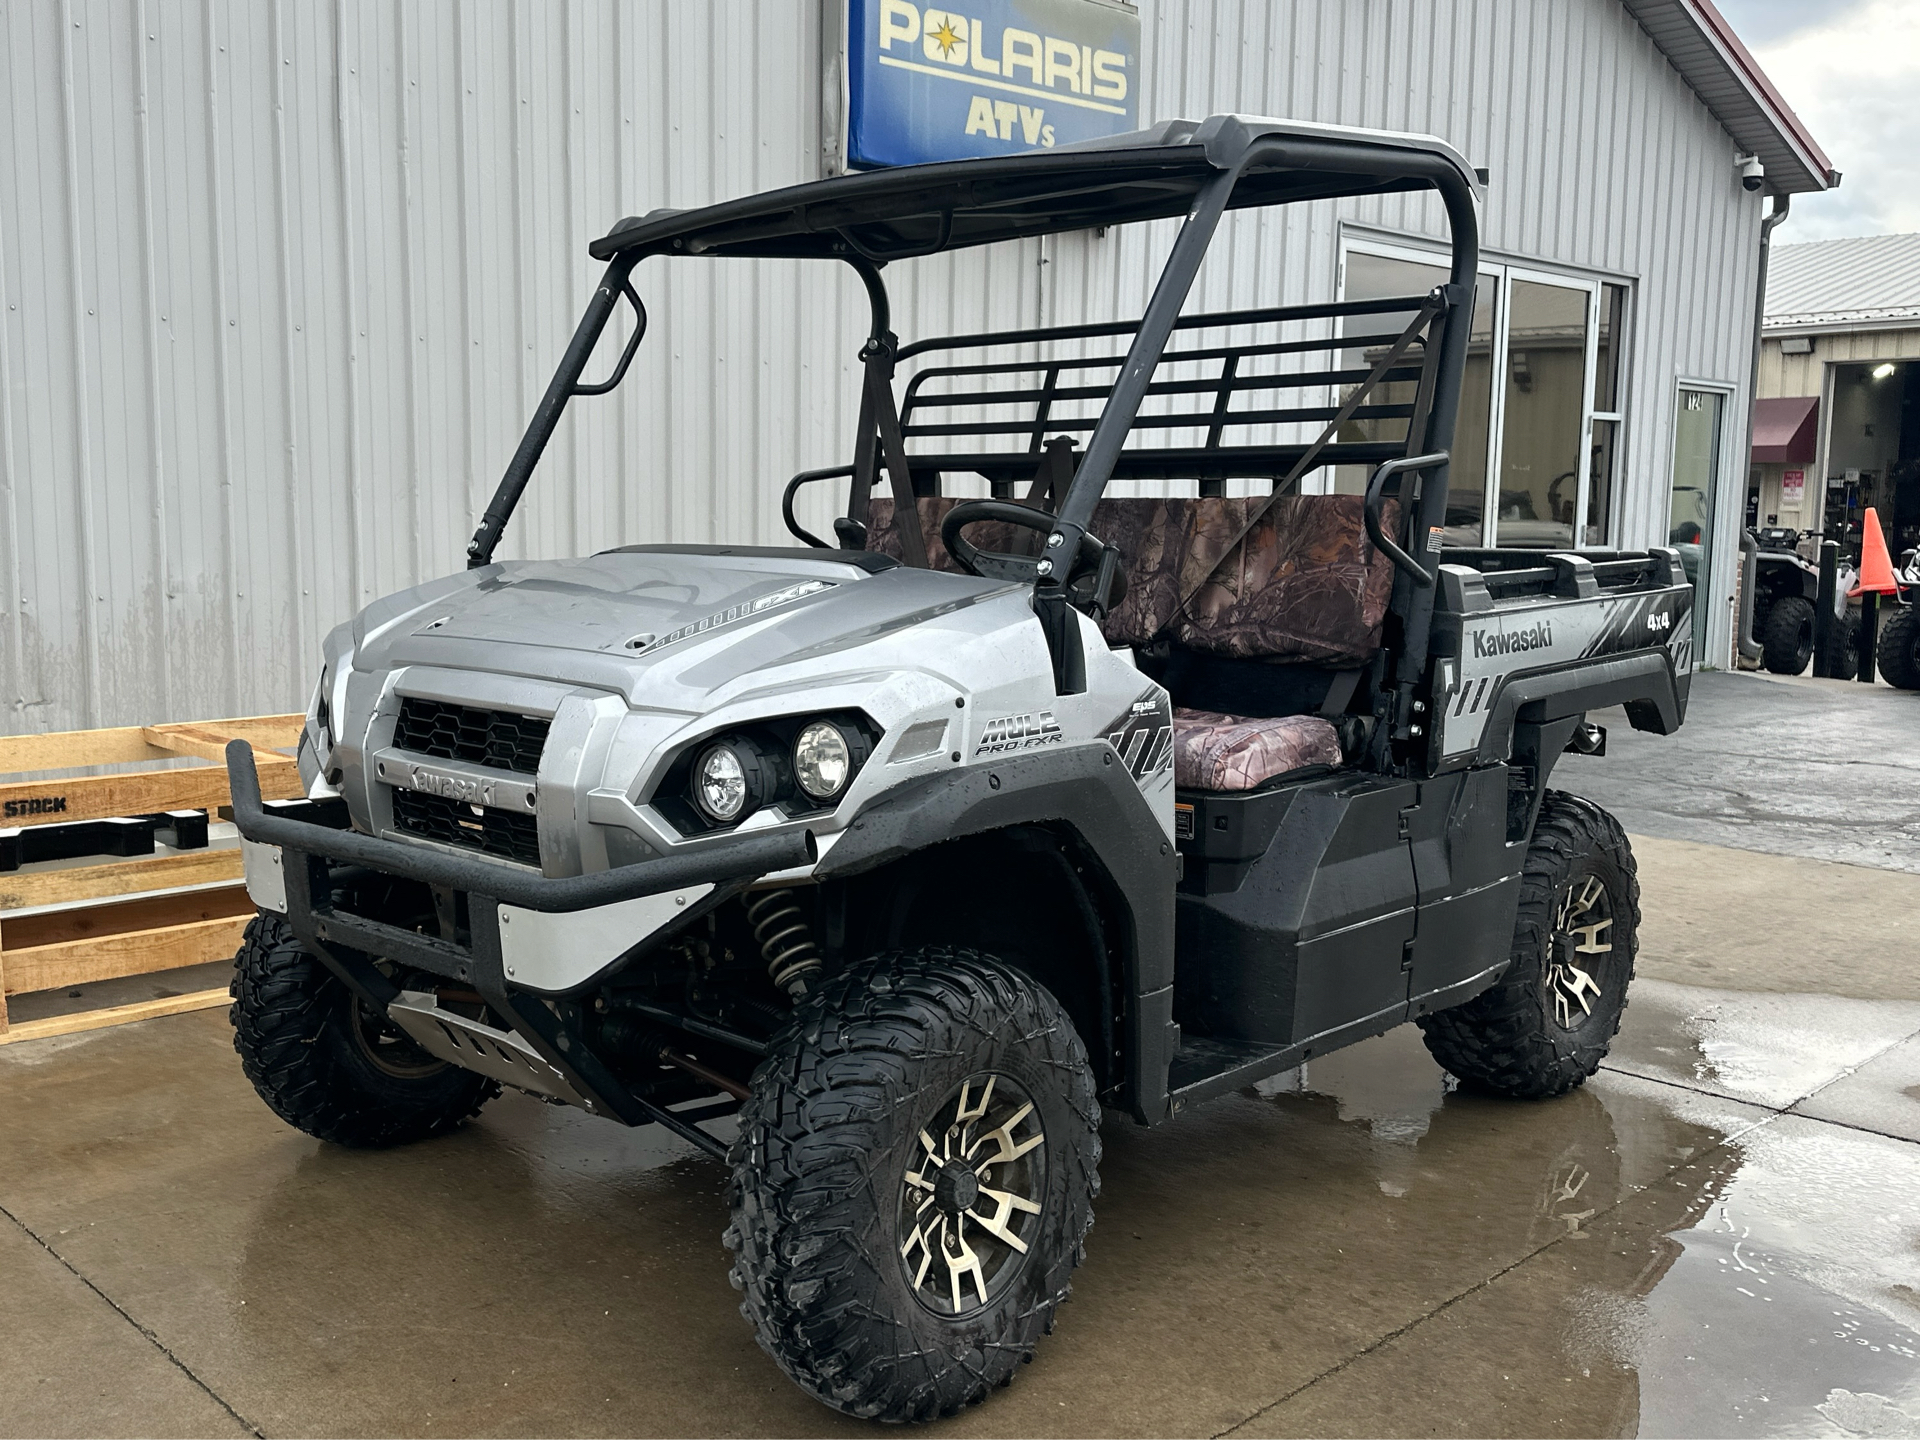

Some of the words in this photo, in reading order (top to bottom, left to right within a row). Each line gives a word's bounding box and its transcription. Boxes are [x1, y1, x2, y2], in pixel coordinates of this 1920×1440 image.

[879, 2, 1127, 100] POLARIS
[964, 95, 1055, 148] ATVs
[1473, 620, 1553, 658] Kawasaki
[1647, 611, 1670, 631] 4x4
[979, 711, 1062, 745] MULE
[407, 763, 497, 806] Kawasaki
[4, 797, 67, 817] STACK
